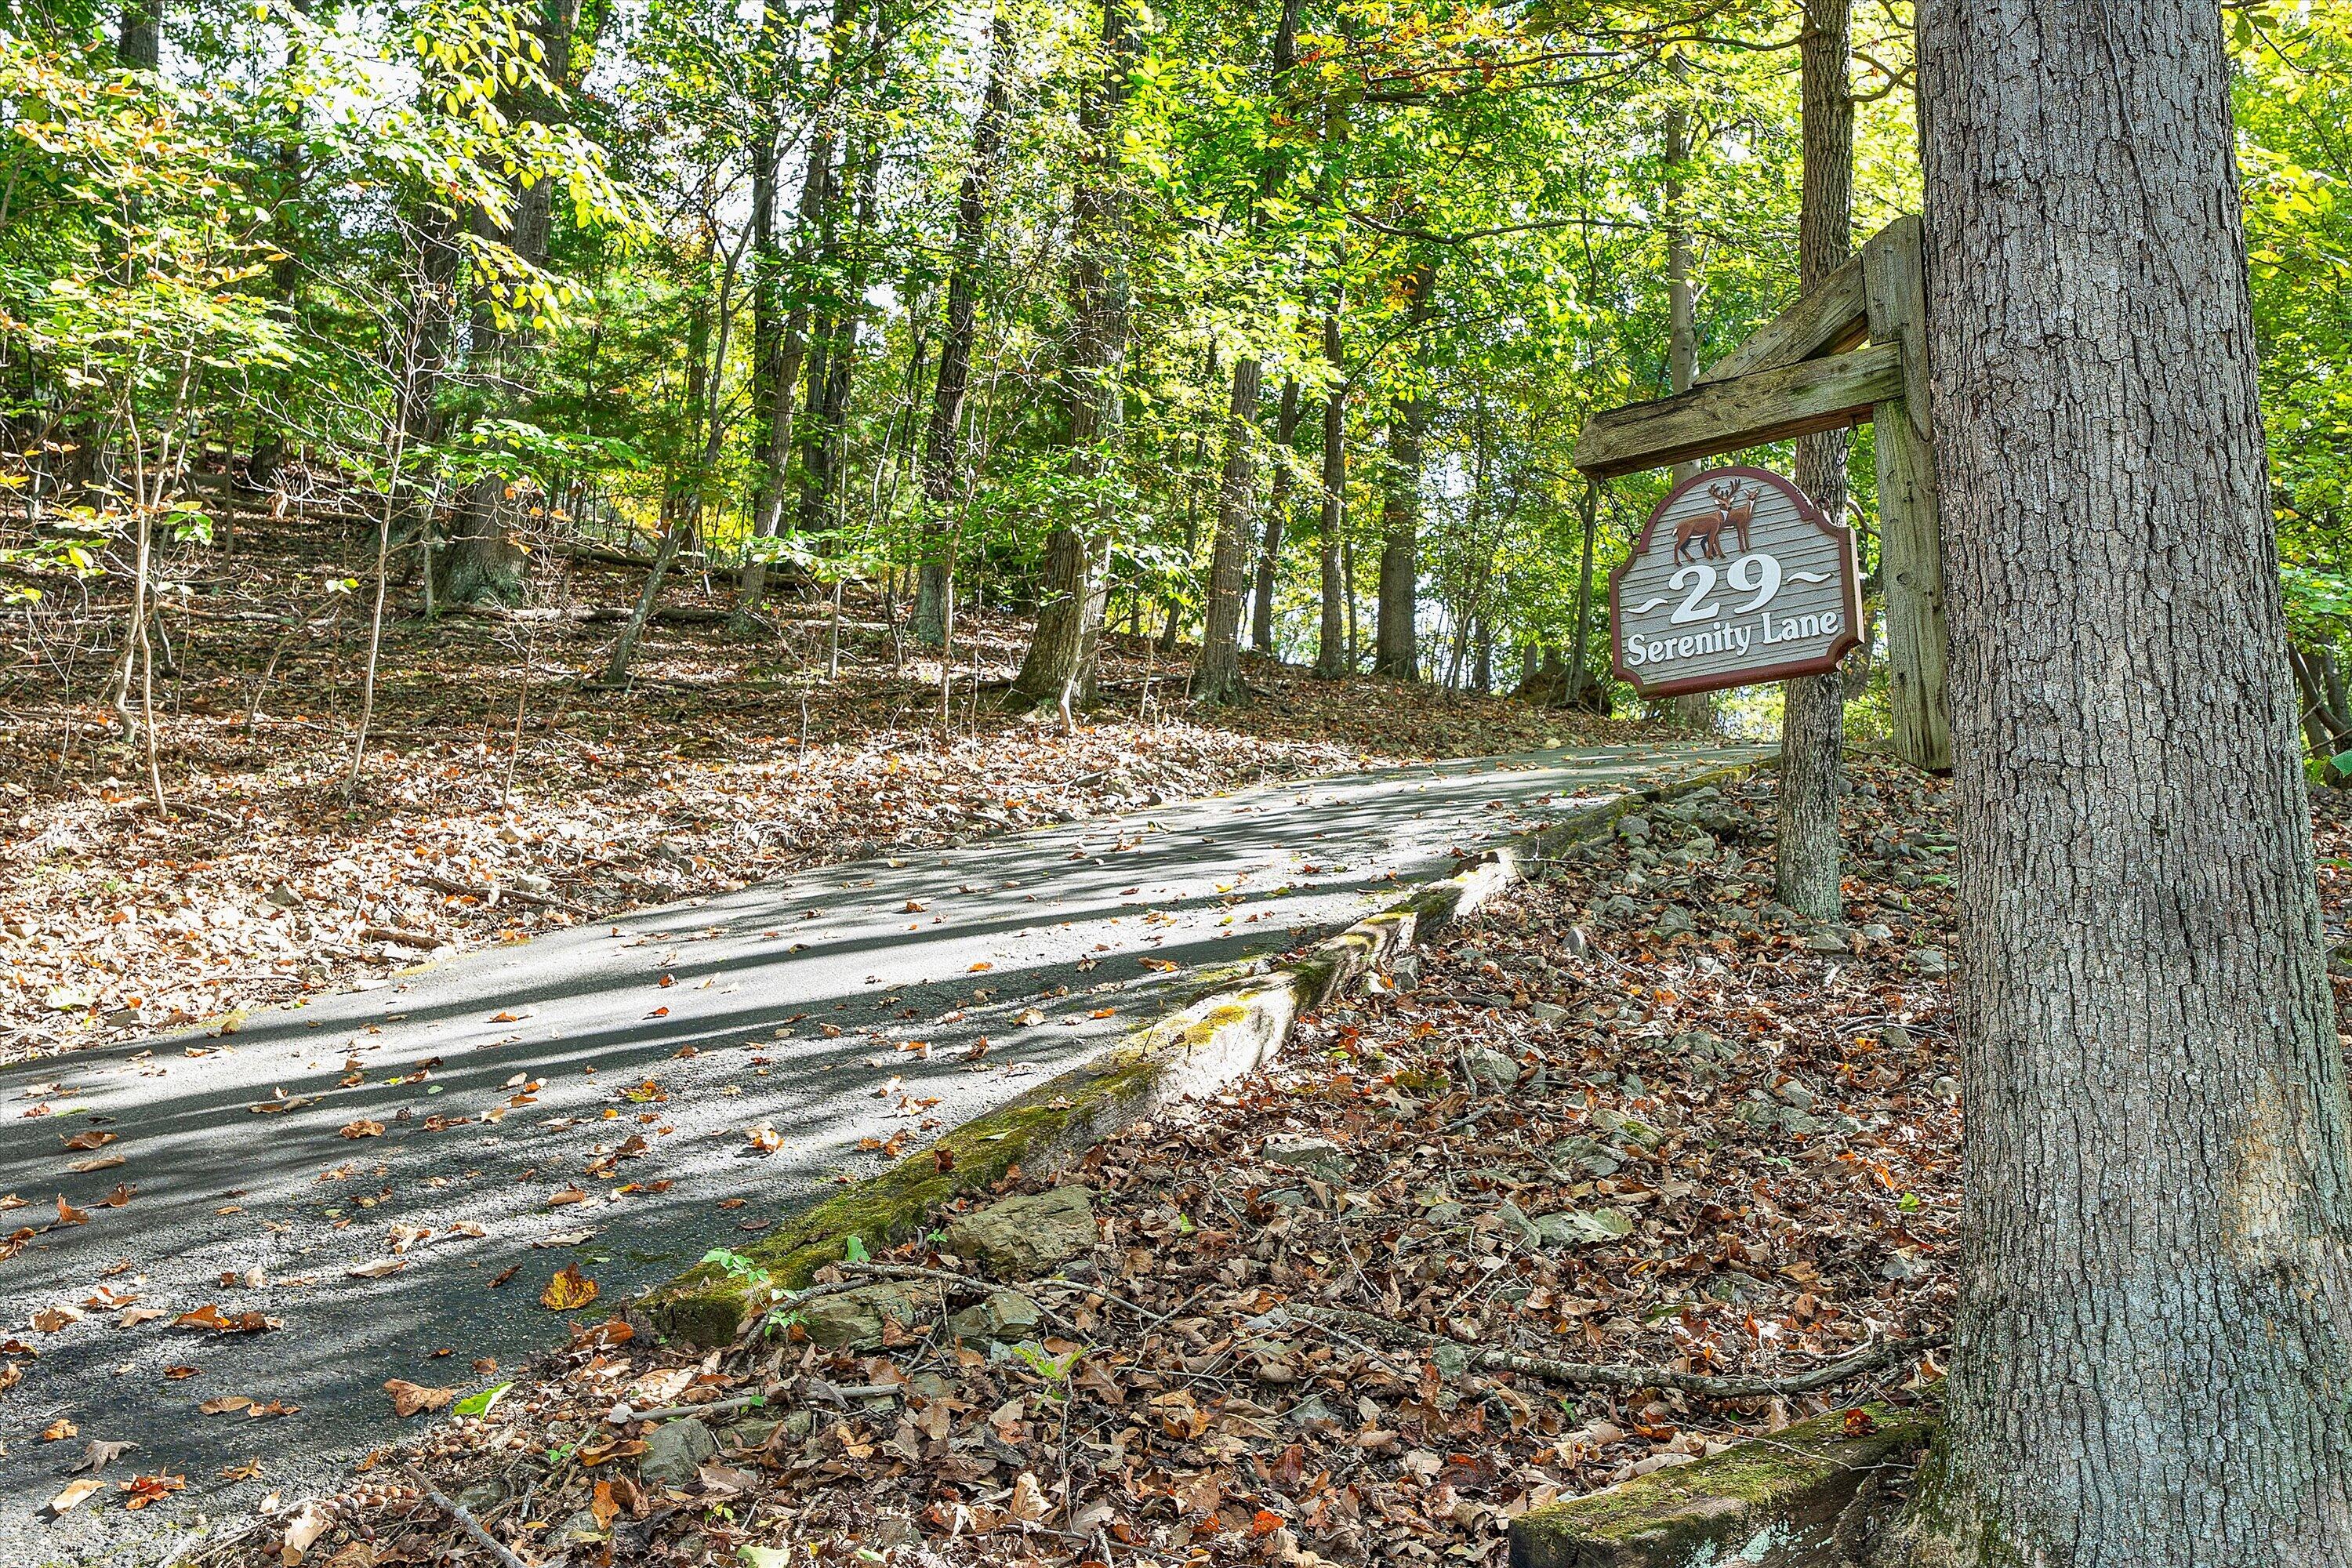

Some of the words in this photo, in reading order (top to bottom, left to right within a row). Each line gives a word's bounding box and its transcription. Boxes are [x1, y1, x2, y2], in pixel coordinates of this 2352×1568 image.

[1668, 554, 1782, 625] 29
[1628, 622, 1751, 666] Serenity
[1761, 612, 1838, 644] Lane
